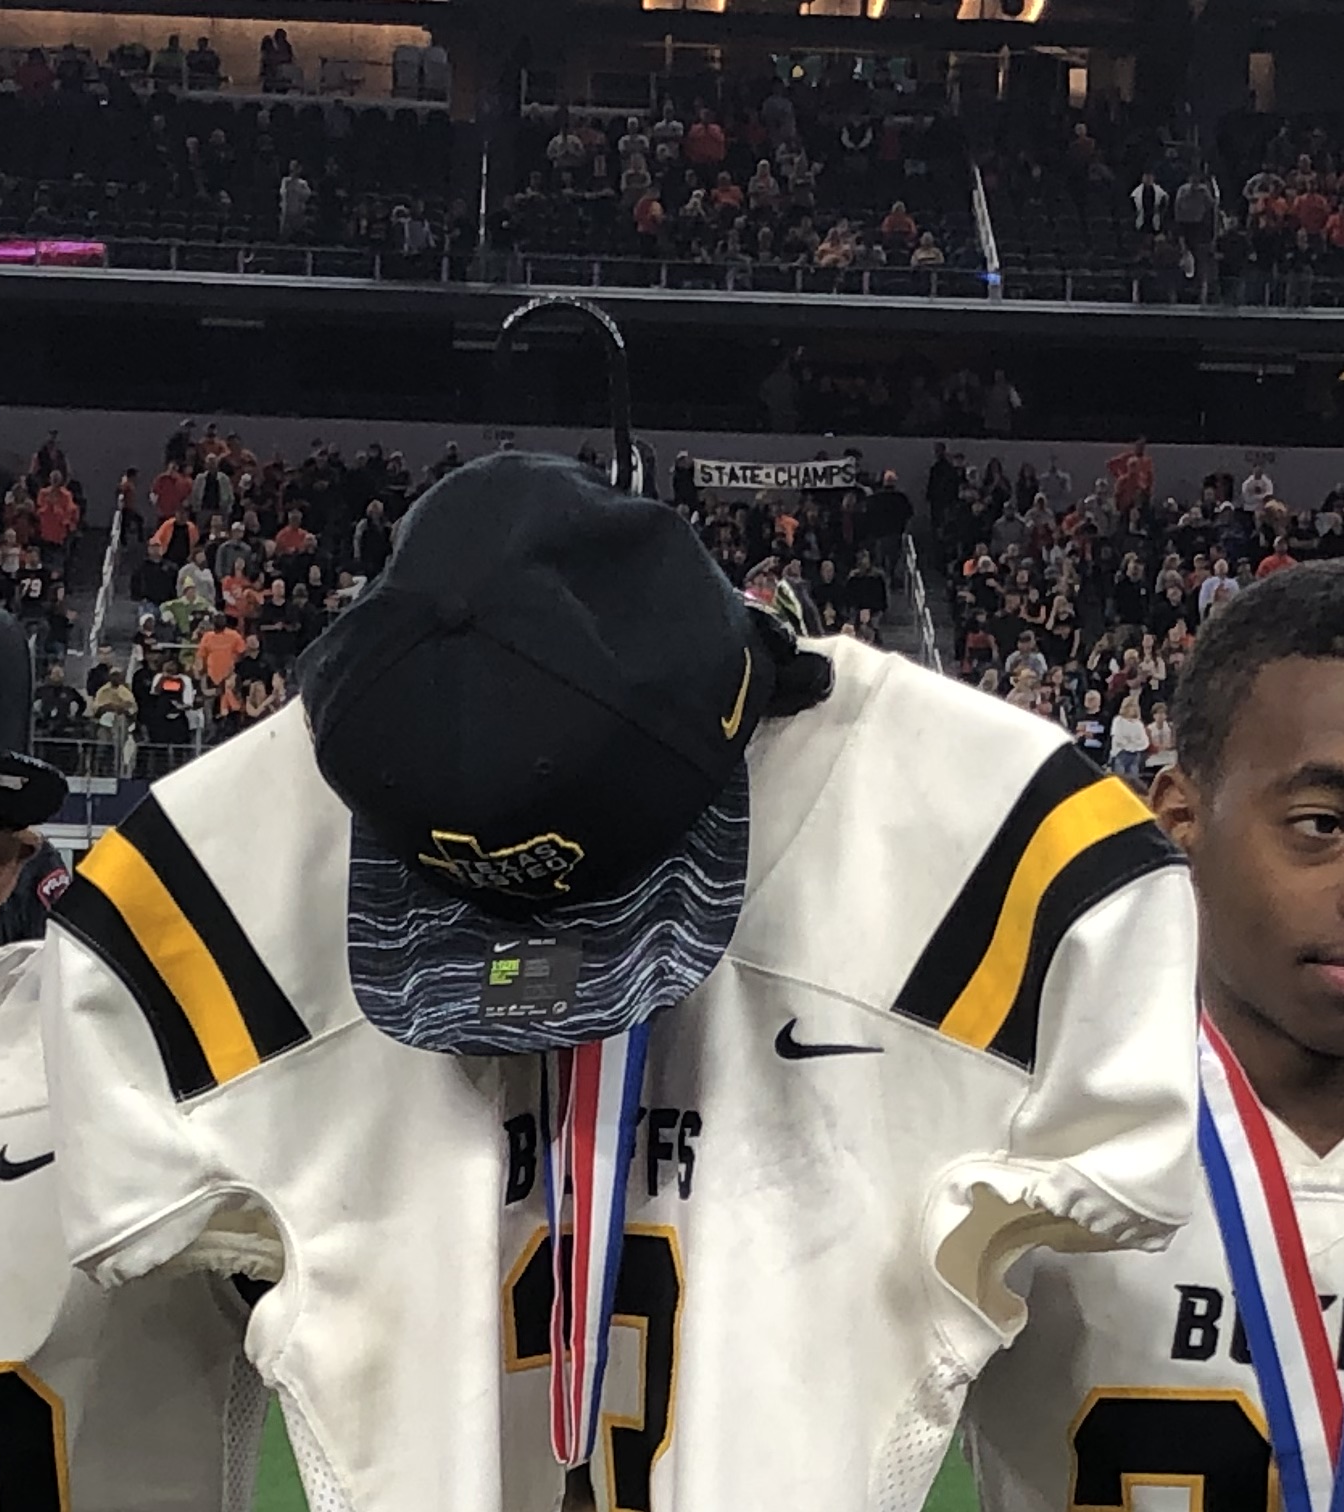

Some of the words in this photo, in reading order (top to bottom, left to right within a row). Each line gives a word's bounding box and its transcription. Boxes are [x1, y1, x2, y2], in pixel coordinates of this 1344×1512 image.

[700, 463, 763, 485] STATE
[774, 463, 854, 488] CHAMPS
[503, 1106, 703, 1207] BFS
